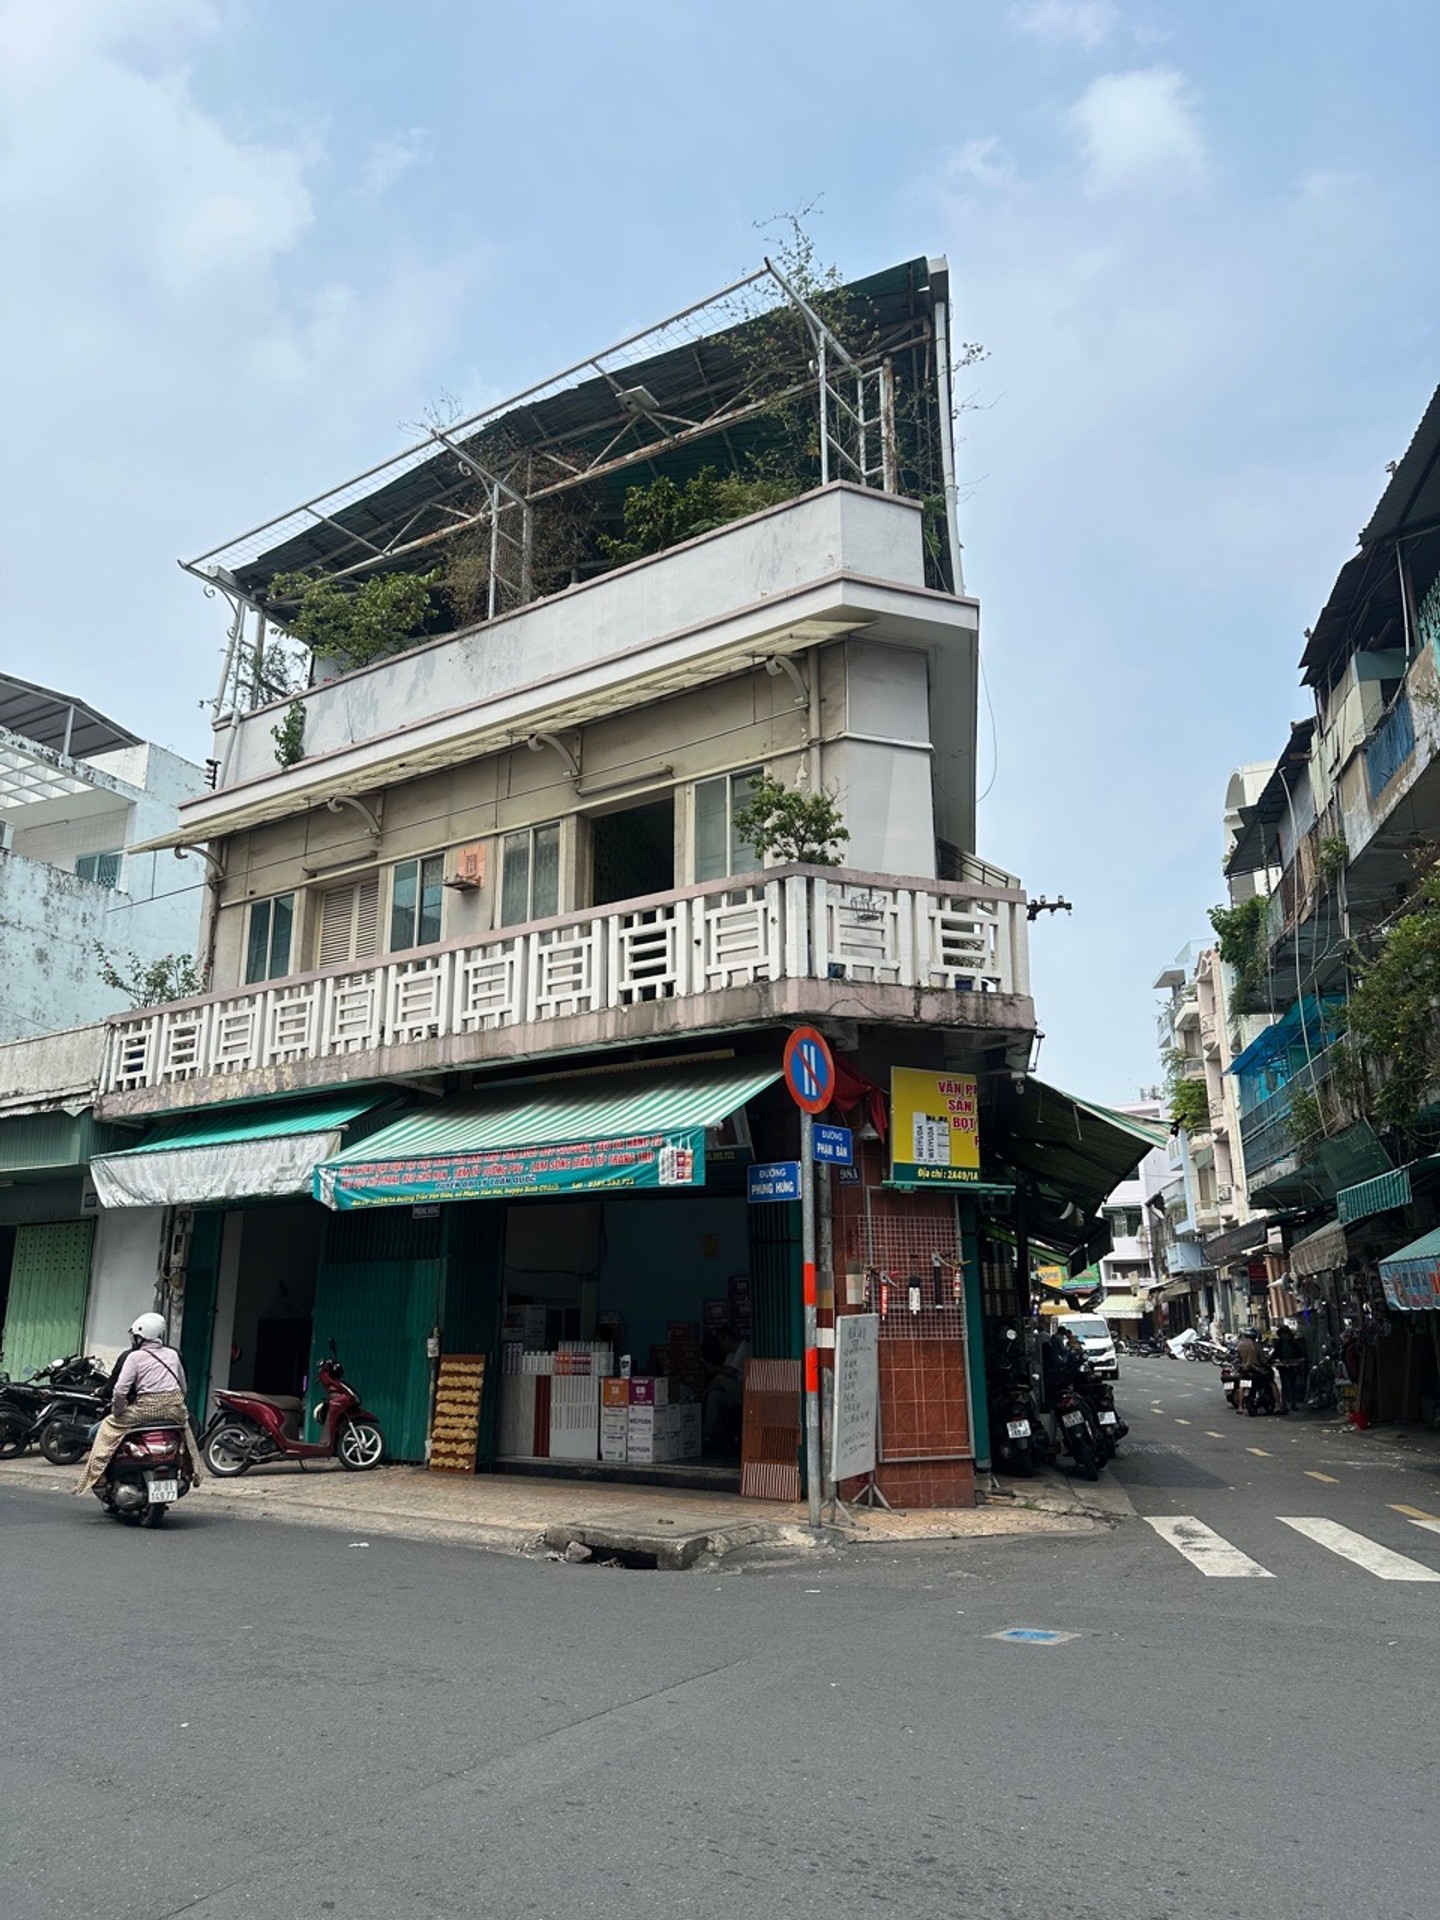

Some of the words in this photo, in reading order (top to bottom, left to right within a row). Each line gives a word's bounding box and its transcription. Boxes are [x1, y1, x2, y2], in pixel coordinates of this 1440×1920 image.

[938, 1080, 961, 1096] VĂN
[948, 1097, 971, 1112] SẢN
[952, 1117, 975, 1132] BỌT
[759, 1168, 787, 1179] ĐƯỜNG
